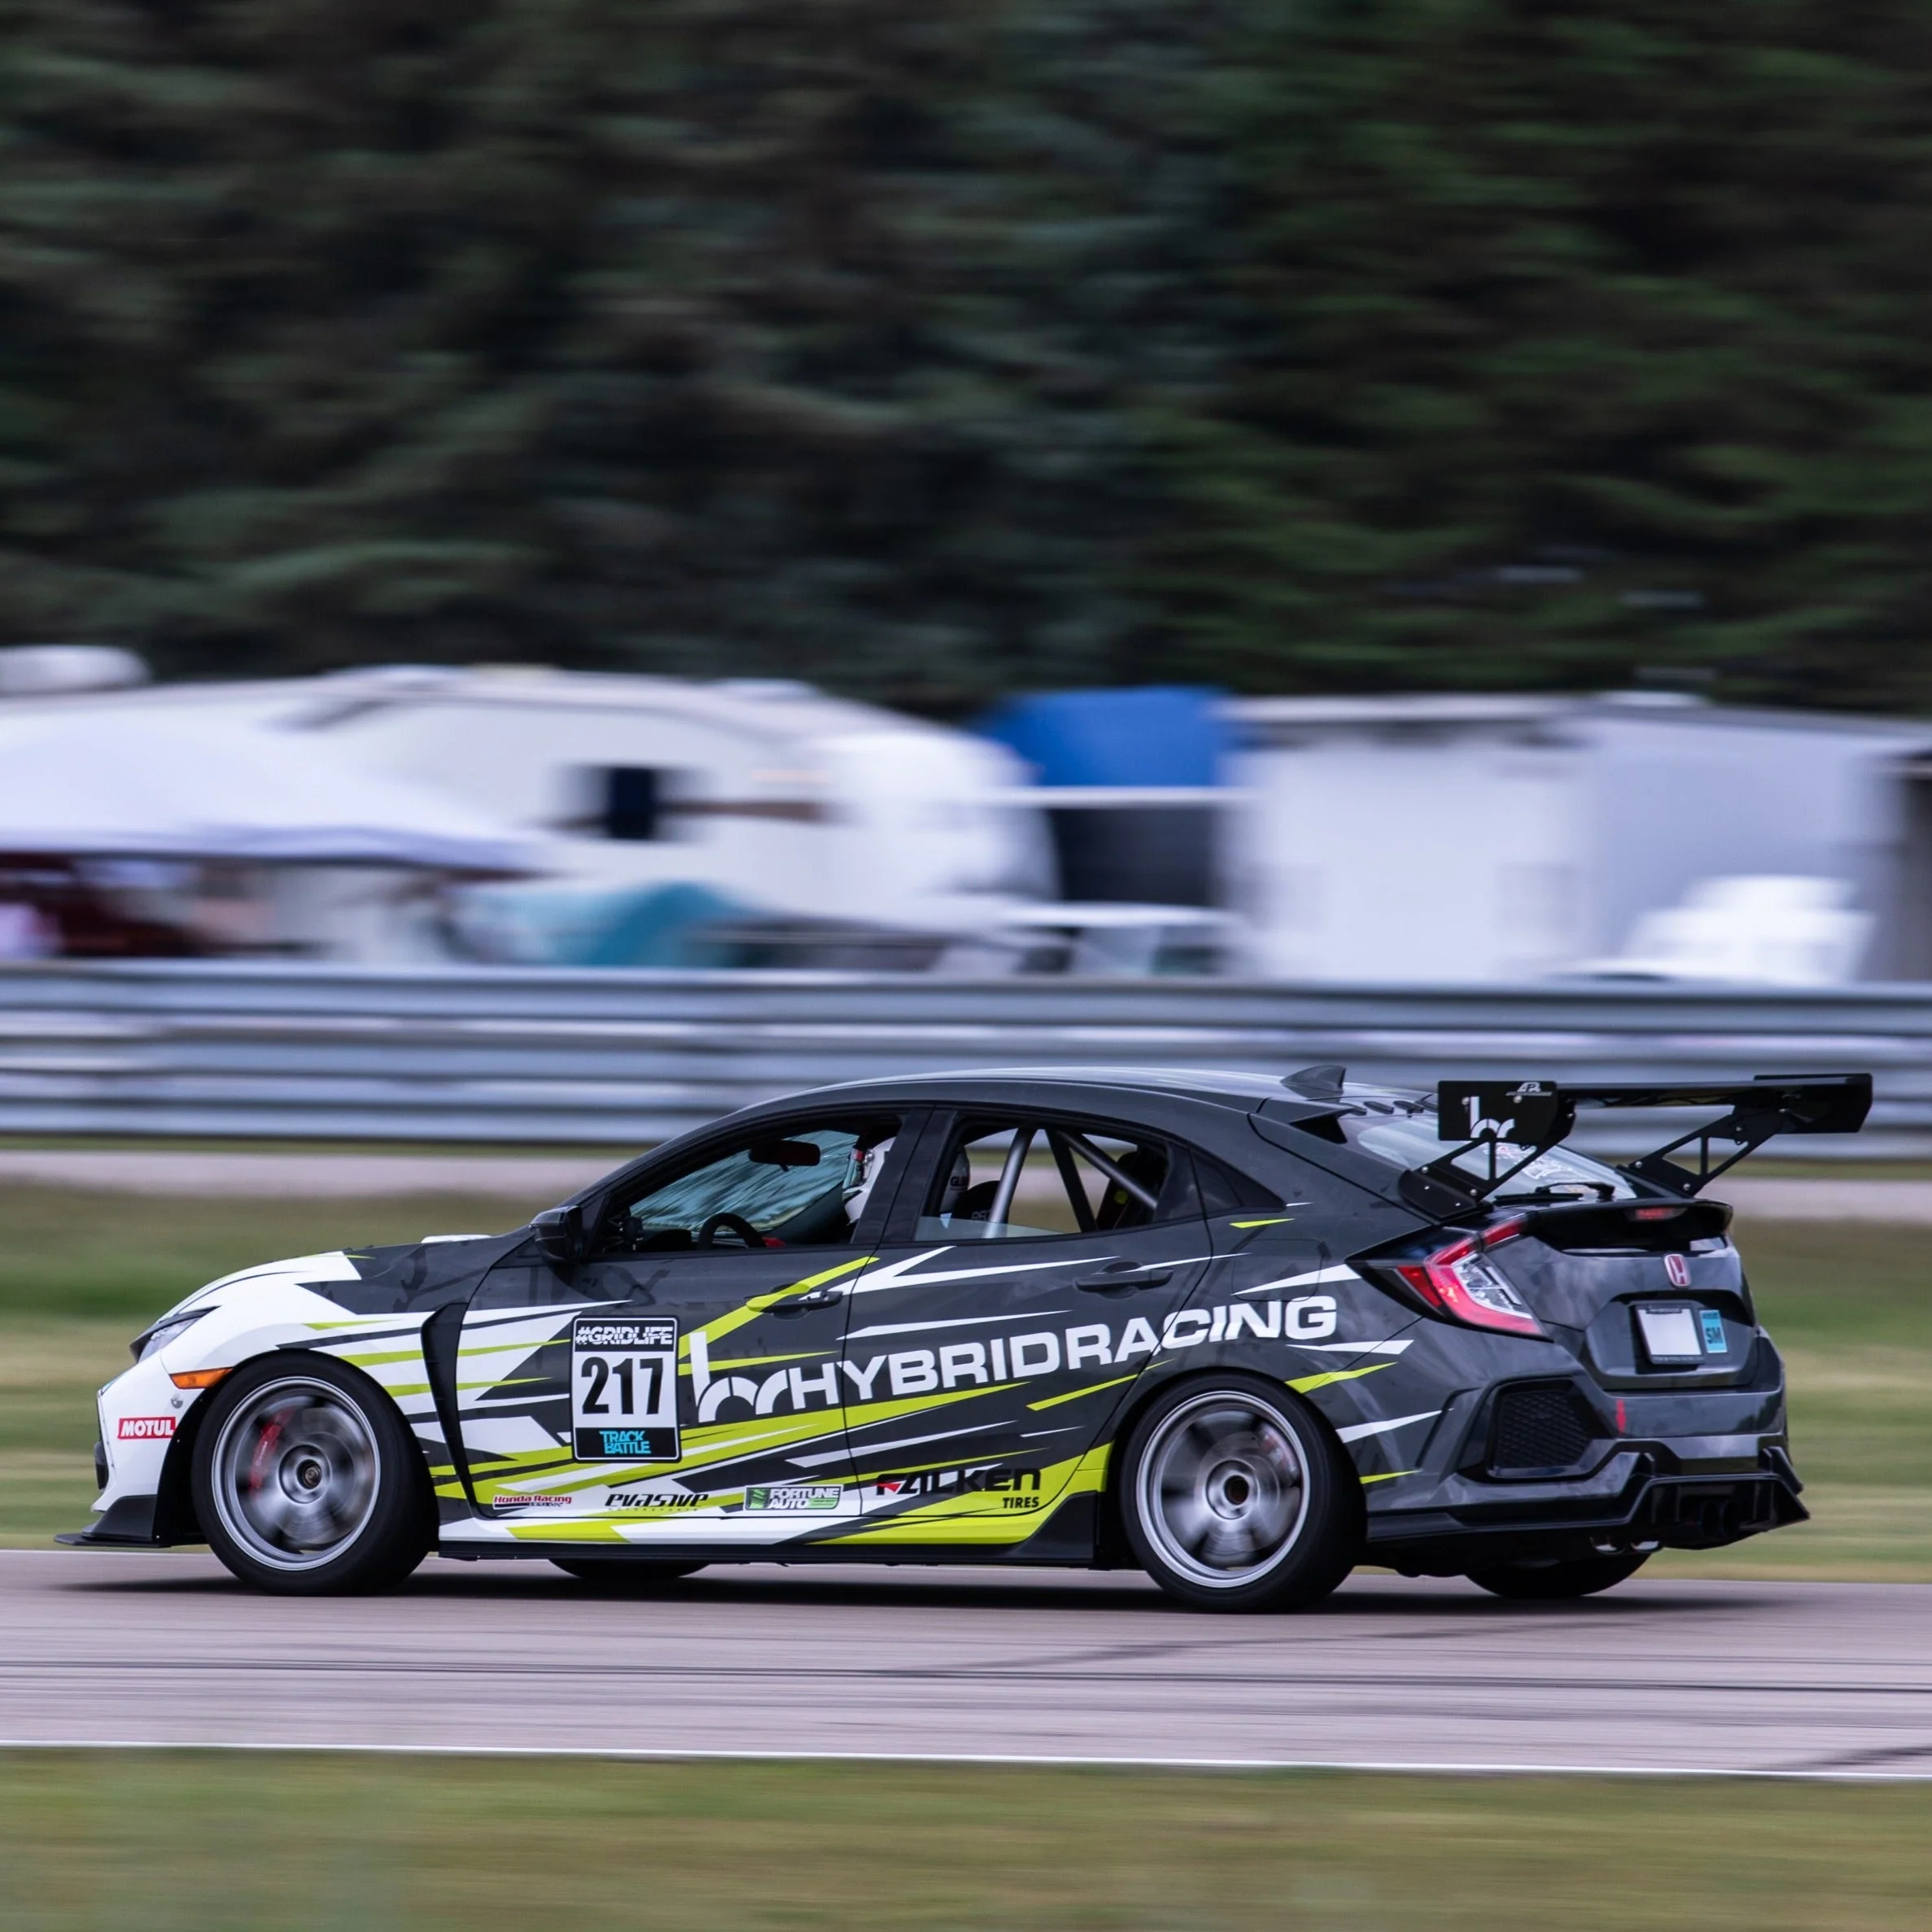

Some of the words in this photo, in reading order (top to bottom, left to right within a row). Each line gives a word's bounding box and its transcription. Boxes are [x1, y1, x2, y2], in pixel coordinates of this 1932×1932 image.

[575, 1327, 674, 1345] #GRIDLIFE
[788, 1296, 1337, 1410] HYBRIDRACING
[580, 1356, 664, 1415] 217
[120, 1419, 175, 1437] MOTUL
[598, 1430, 645, 1443] TRACK
[605, 1440, 652, 1454] BATTLE
[494, 1495, 531, 1503] Honda
[534, 1495, 572, 1504] Racing
[768, 1487, 840, 1499] FORTUNE
[766, 1498, 811, 1510] AUTO
[1003, 1496, 1040, 1509] TIRES
